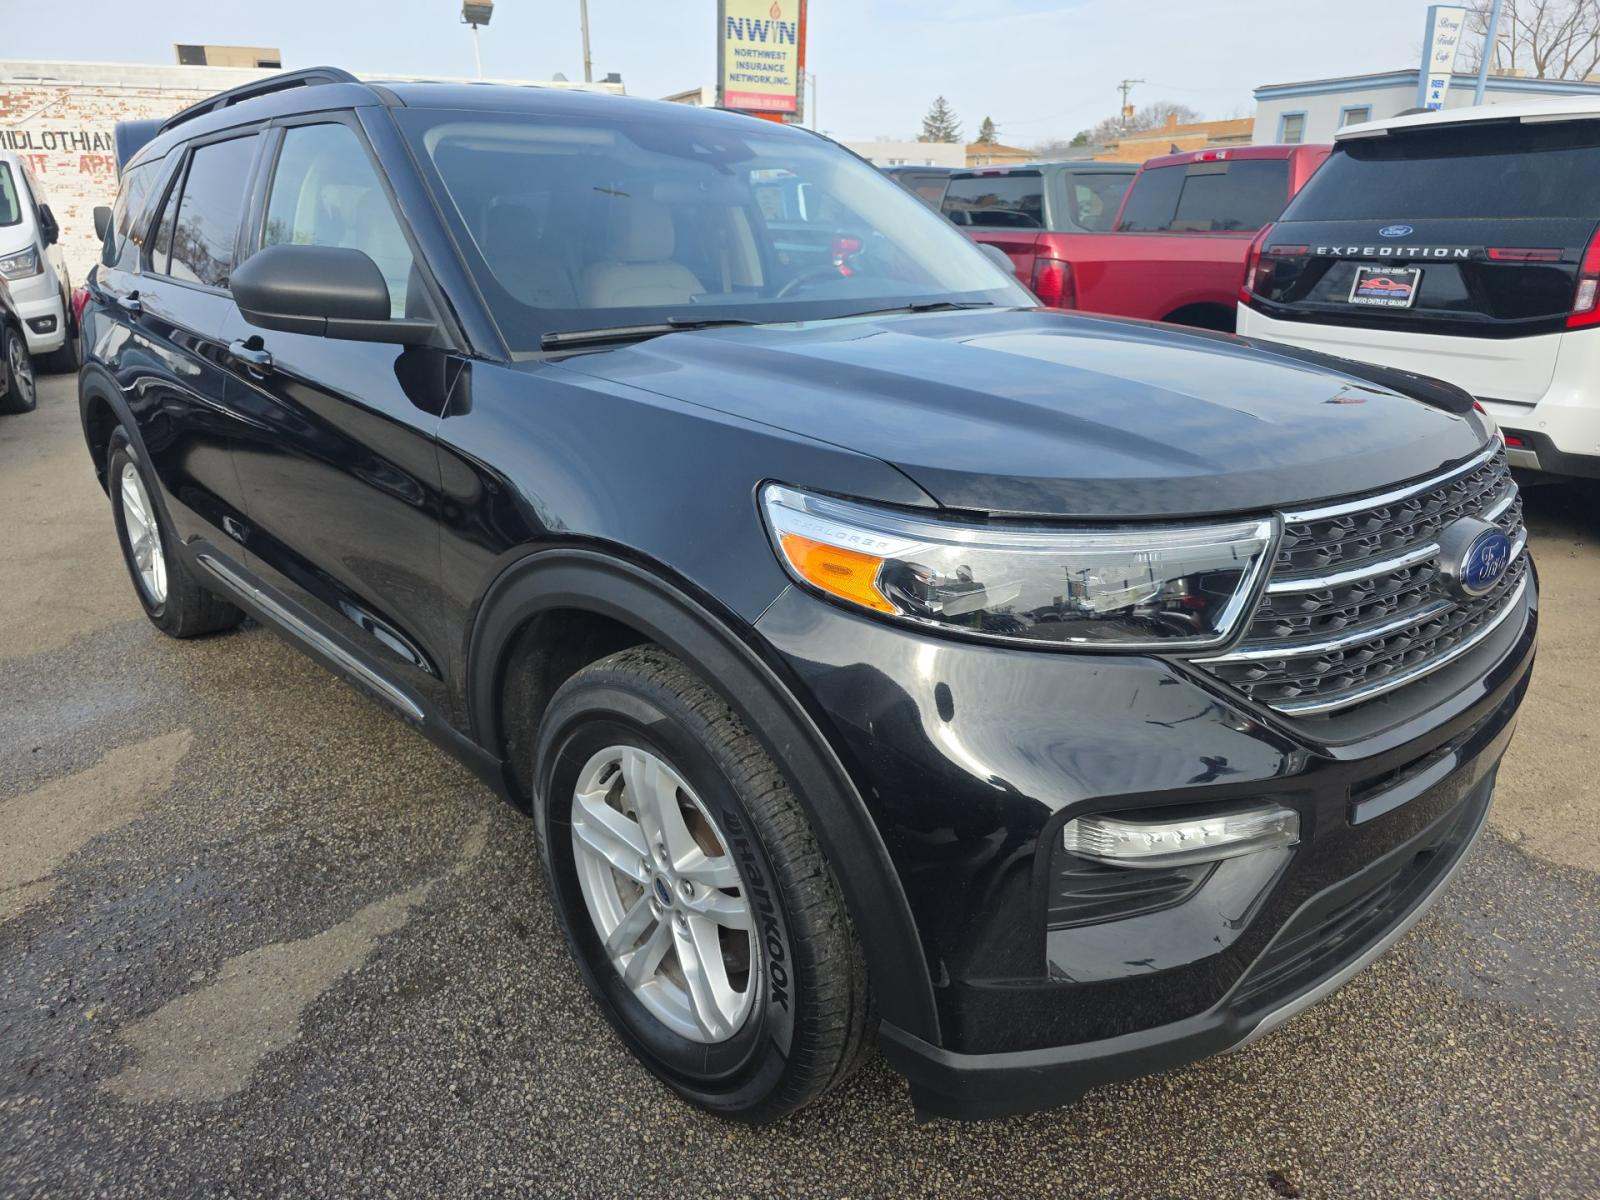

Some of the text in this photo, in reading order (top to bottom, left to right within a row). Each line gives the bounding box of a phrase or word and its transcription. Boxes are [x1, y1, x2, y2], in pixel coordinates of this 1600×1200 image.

[734, 48, 787, 60] NORTHWEST
[736, 61, 785, 73] INSURANCE
[1316, 246, 1469, 258] EXPEDITION
[1479, 541, 1507, 580] Ford
